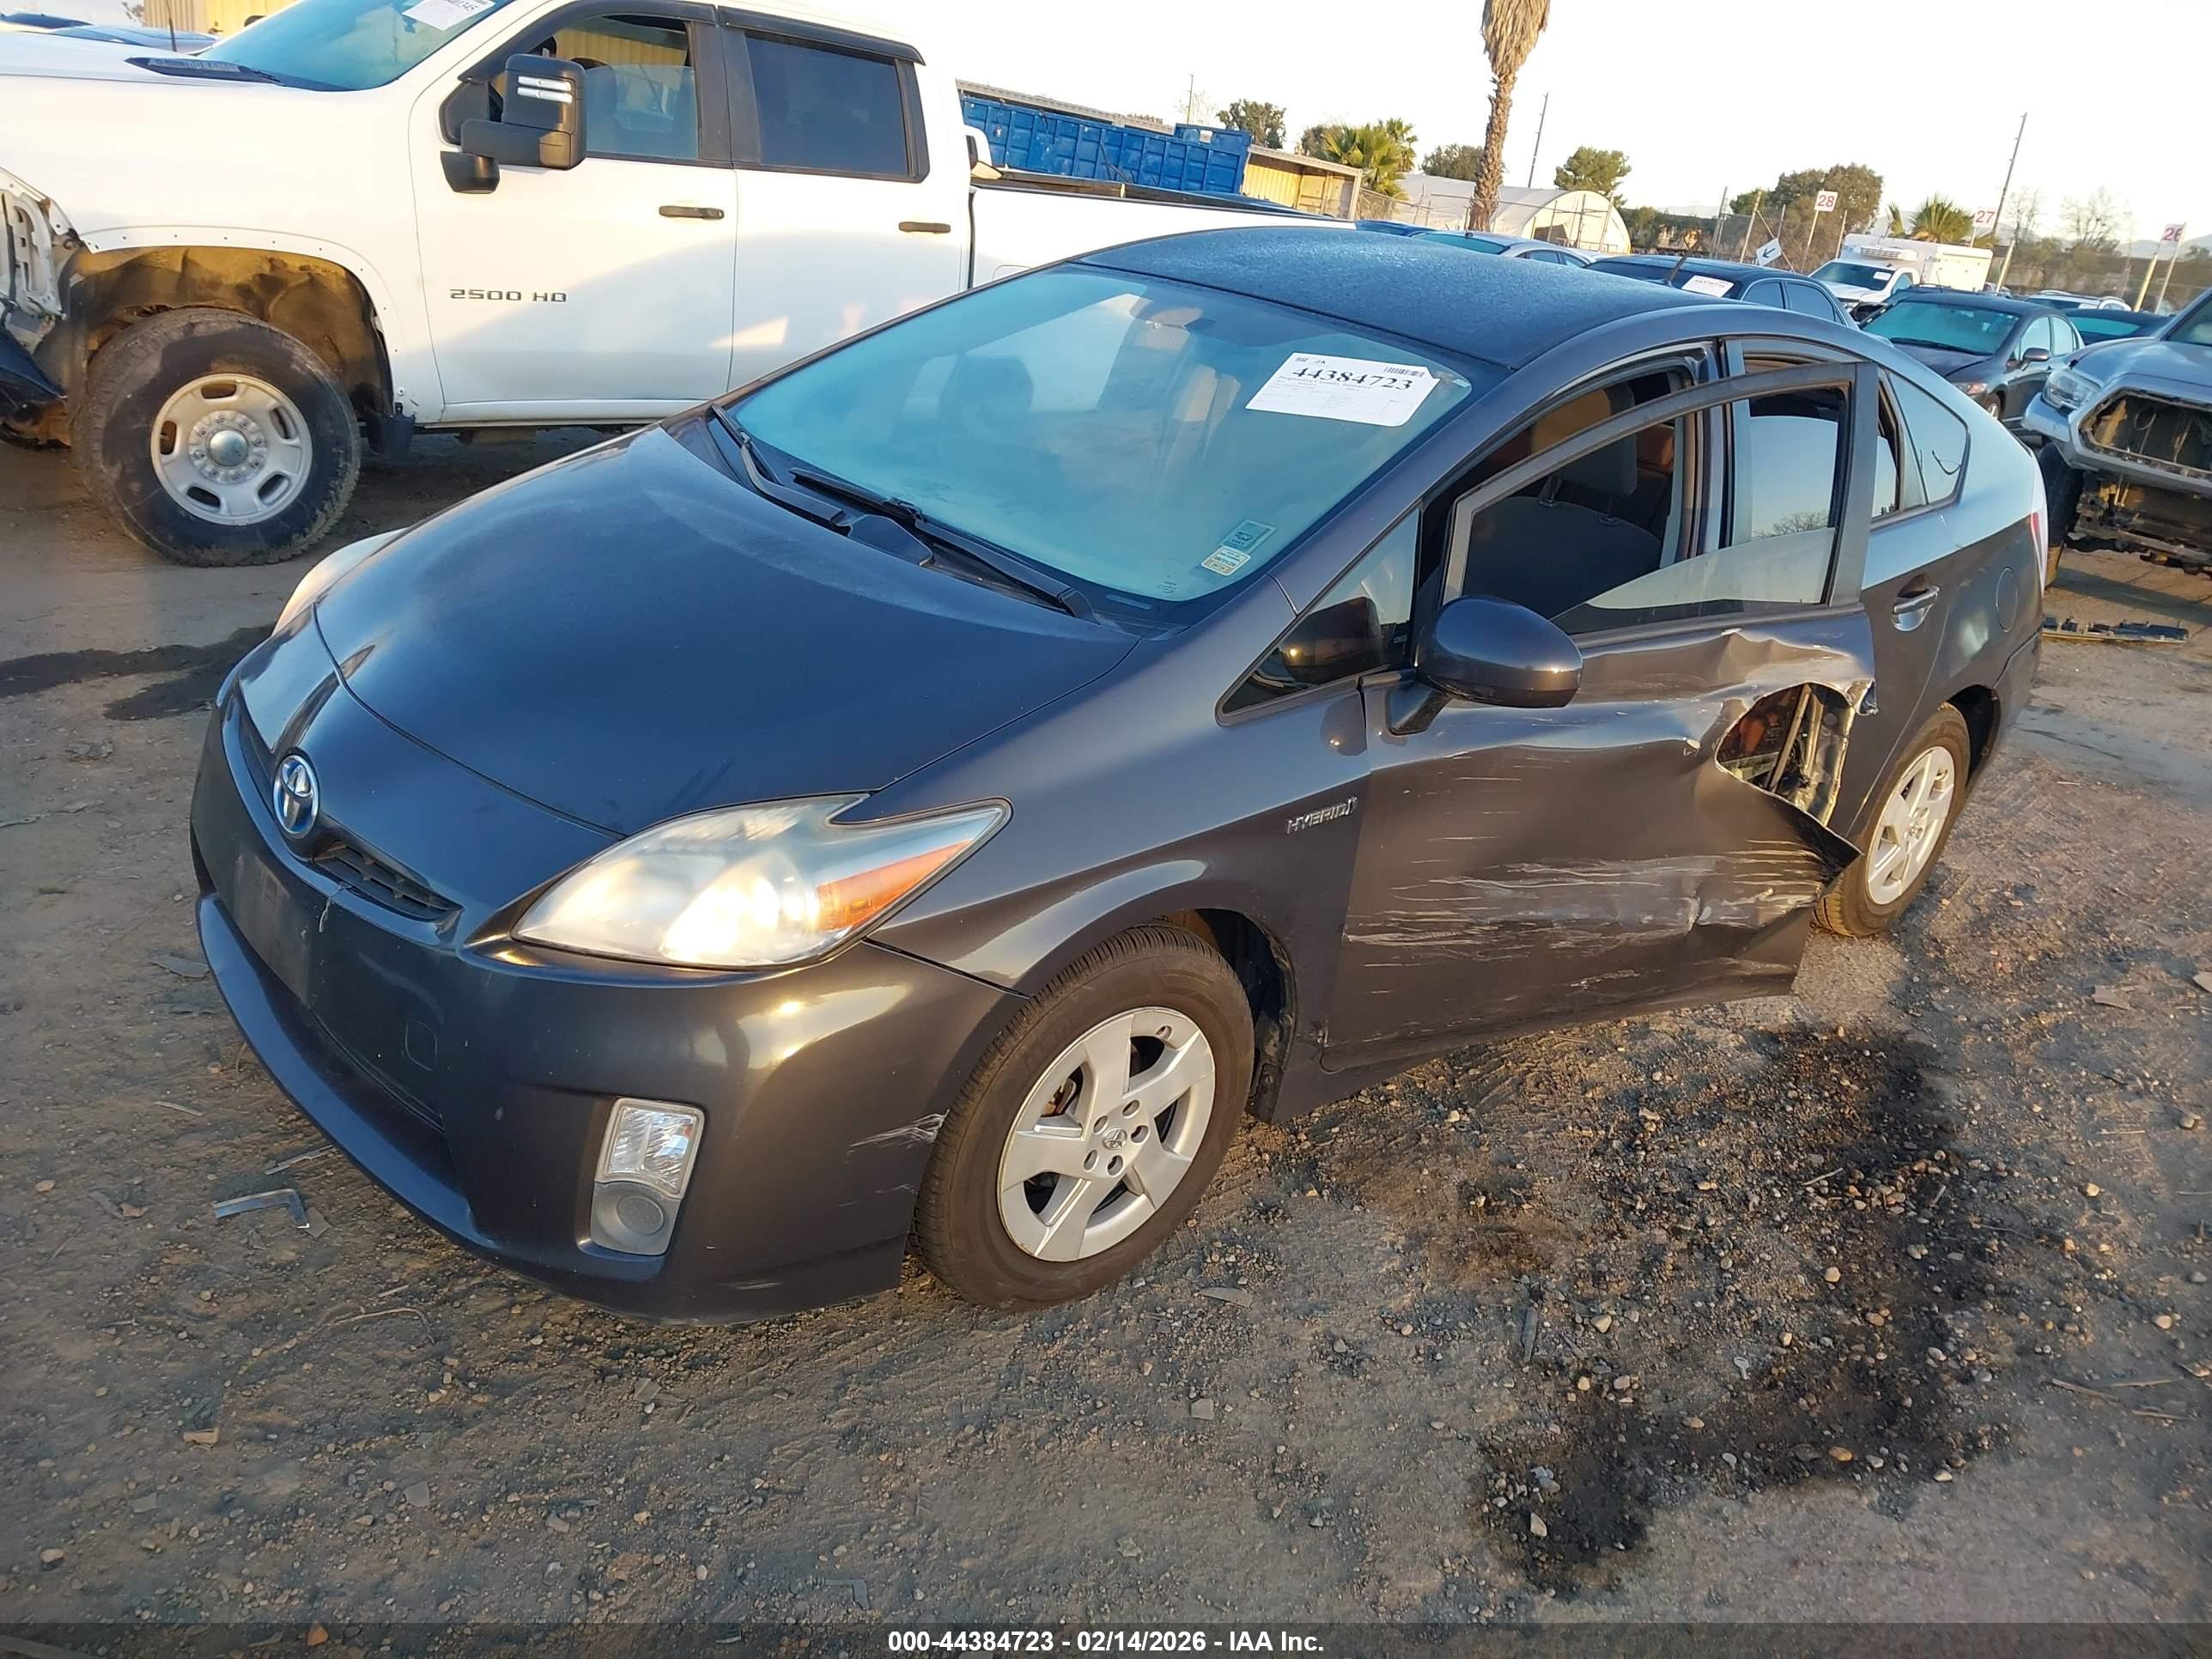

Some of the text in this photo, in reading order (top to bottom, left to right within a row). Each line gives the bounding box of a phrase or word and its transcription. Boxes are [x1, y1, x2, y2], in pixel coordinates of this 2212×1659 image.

[1818, 195, 1834, 207] 28
[1975, 210, 1996, 223] 27
[449, 289, 567, 302] 2500 HD
[1292, 368, 1413, 390] 44384723
[1286, 800, 1350, 835] HYBRID
